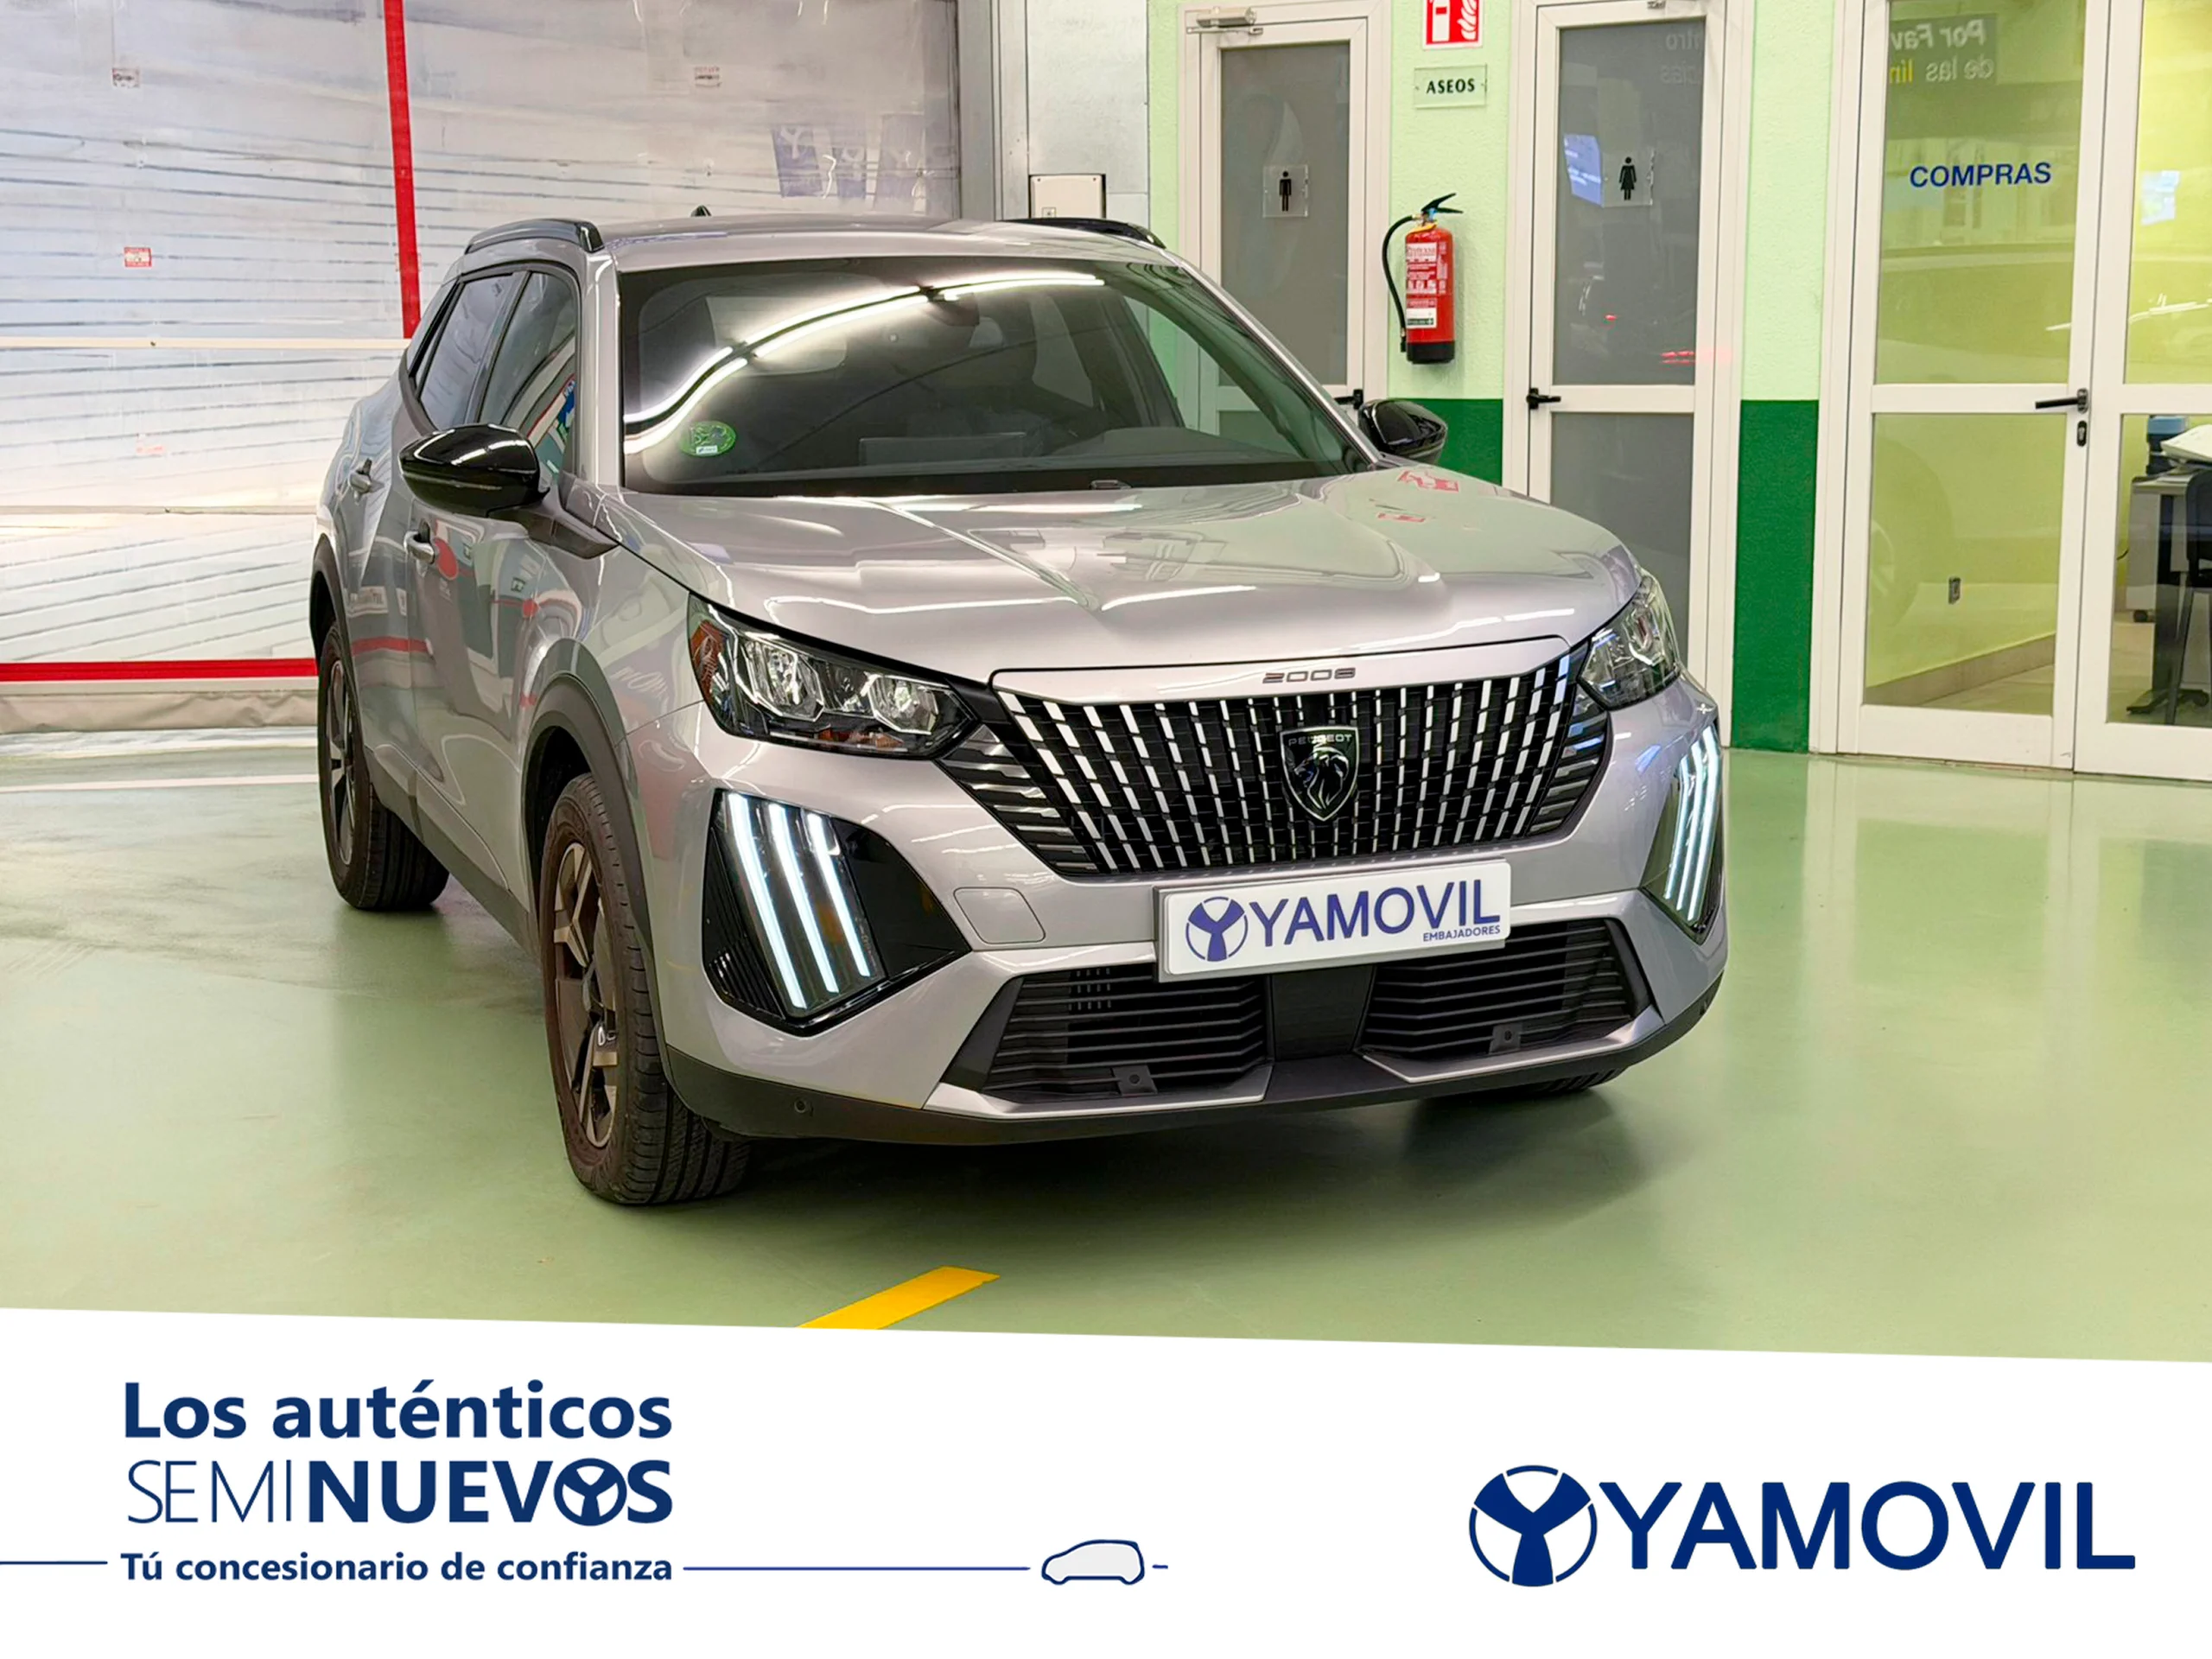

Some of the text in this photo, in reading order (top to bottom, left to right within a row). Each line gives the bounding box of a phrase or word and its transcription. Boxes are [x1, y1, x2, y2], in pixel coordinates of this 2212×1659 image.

[1426, 78, 1475, 94] ASEOS
[1910, 162, 2051, 188] COMPRAS
[1262, 667, 1356, 683] 2008
[1249, 879, 1501, 947] YAMOVIL
[1423, 925, 1501, 942] EMBAJADORES
